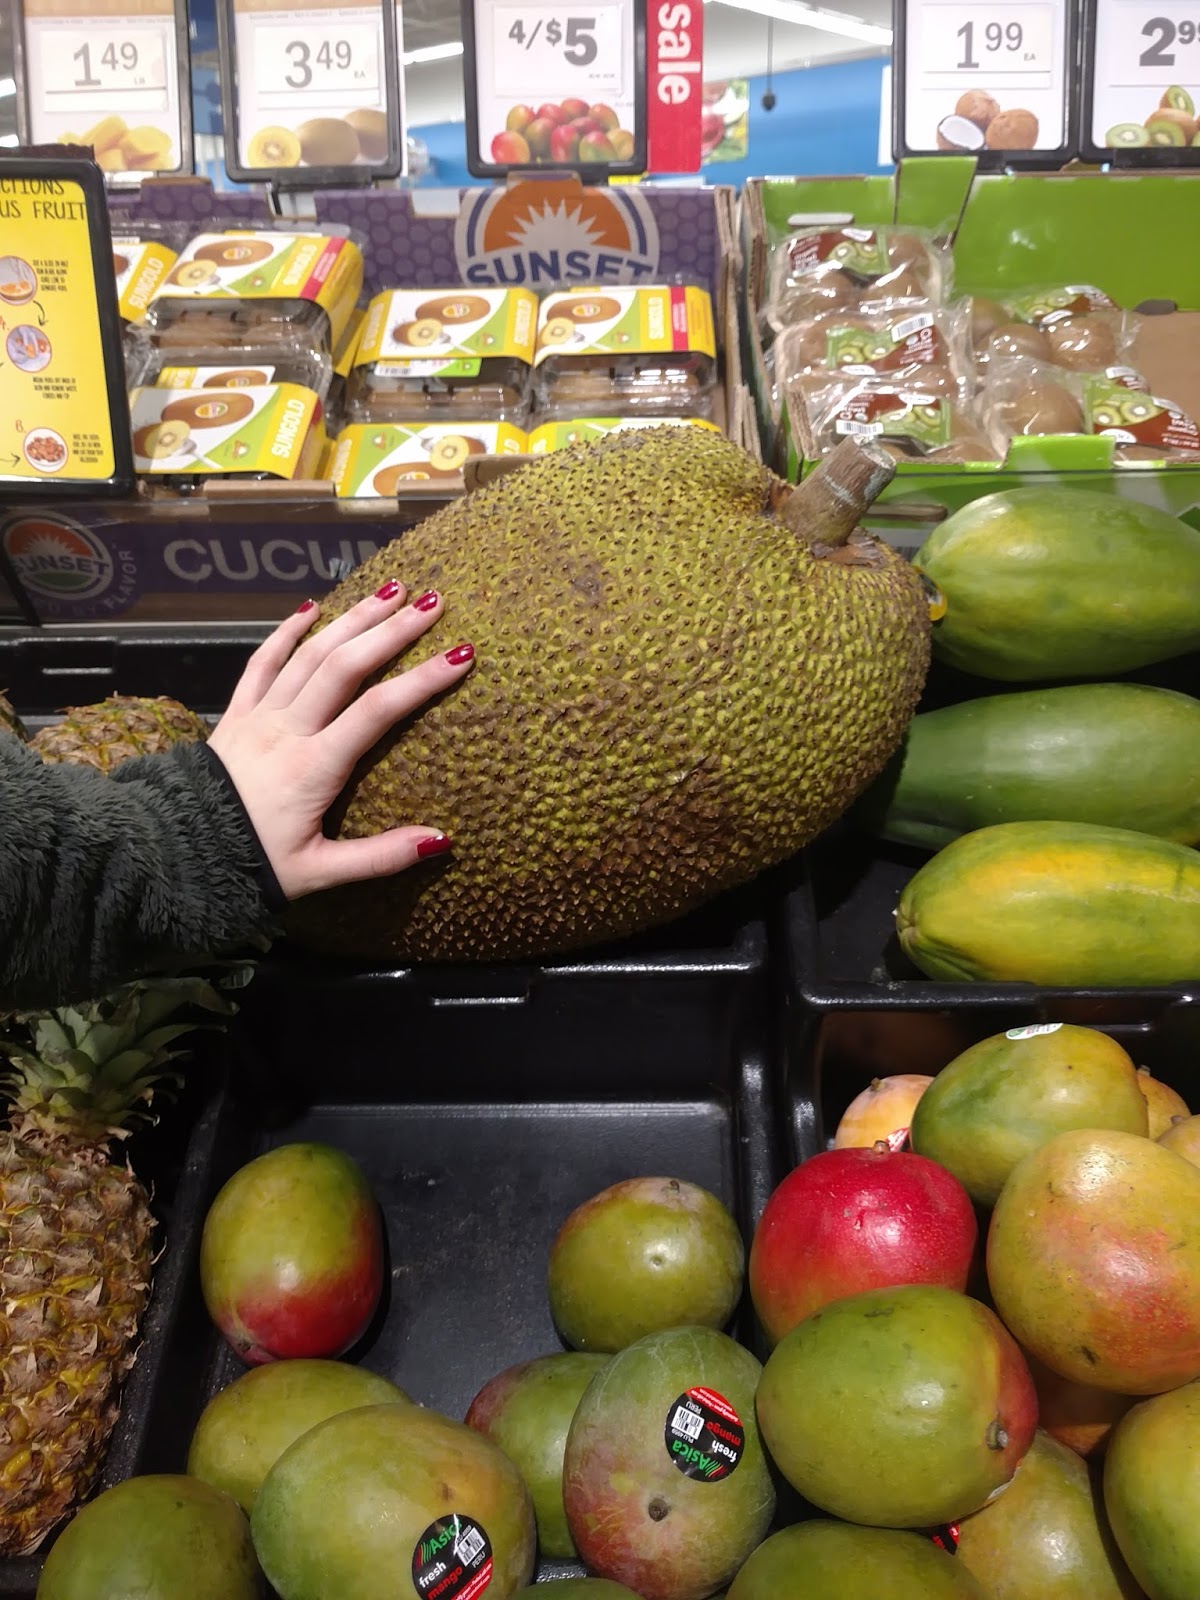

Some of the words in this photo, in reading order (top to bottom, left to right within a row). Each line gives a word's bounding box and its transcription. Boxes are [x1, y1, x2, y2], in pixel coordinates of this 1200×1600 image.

[657, 3, 701, 105] sale
[1139, 17, 1200, 66] 29
[33, 201, 85, 220] FRUIT
[467, 250, 653, 284] SUNSET
[271, 399, 305, 458] SUNGOLD
[103, 550, 137, 609] FLAVOR
[685, 1400, 702, 1415] PERU
[706, 1421, 741, 1446] mango
[672, 1440, 711, 1470] Asica
[712, 1440, 737, 1463] fresh
[418, 1562, 447, 1588] fresh
[427, 1566, 463, 1600] mango
